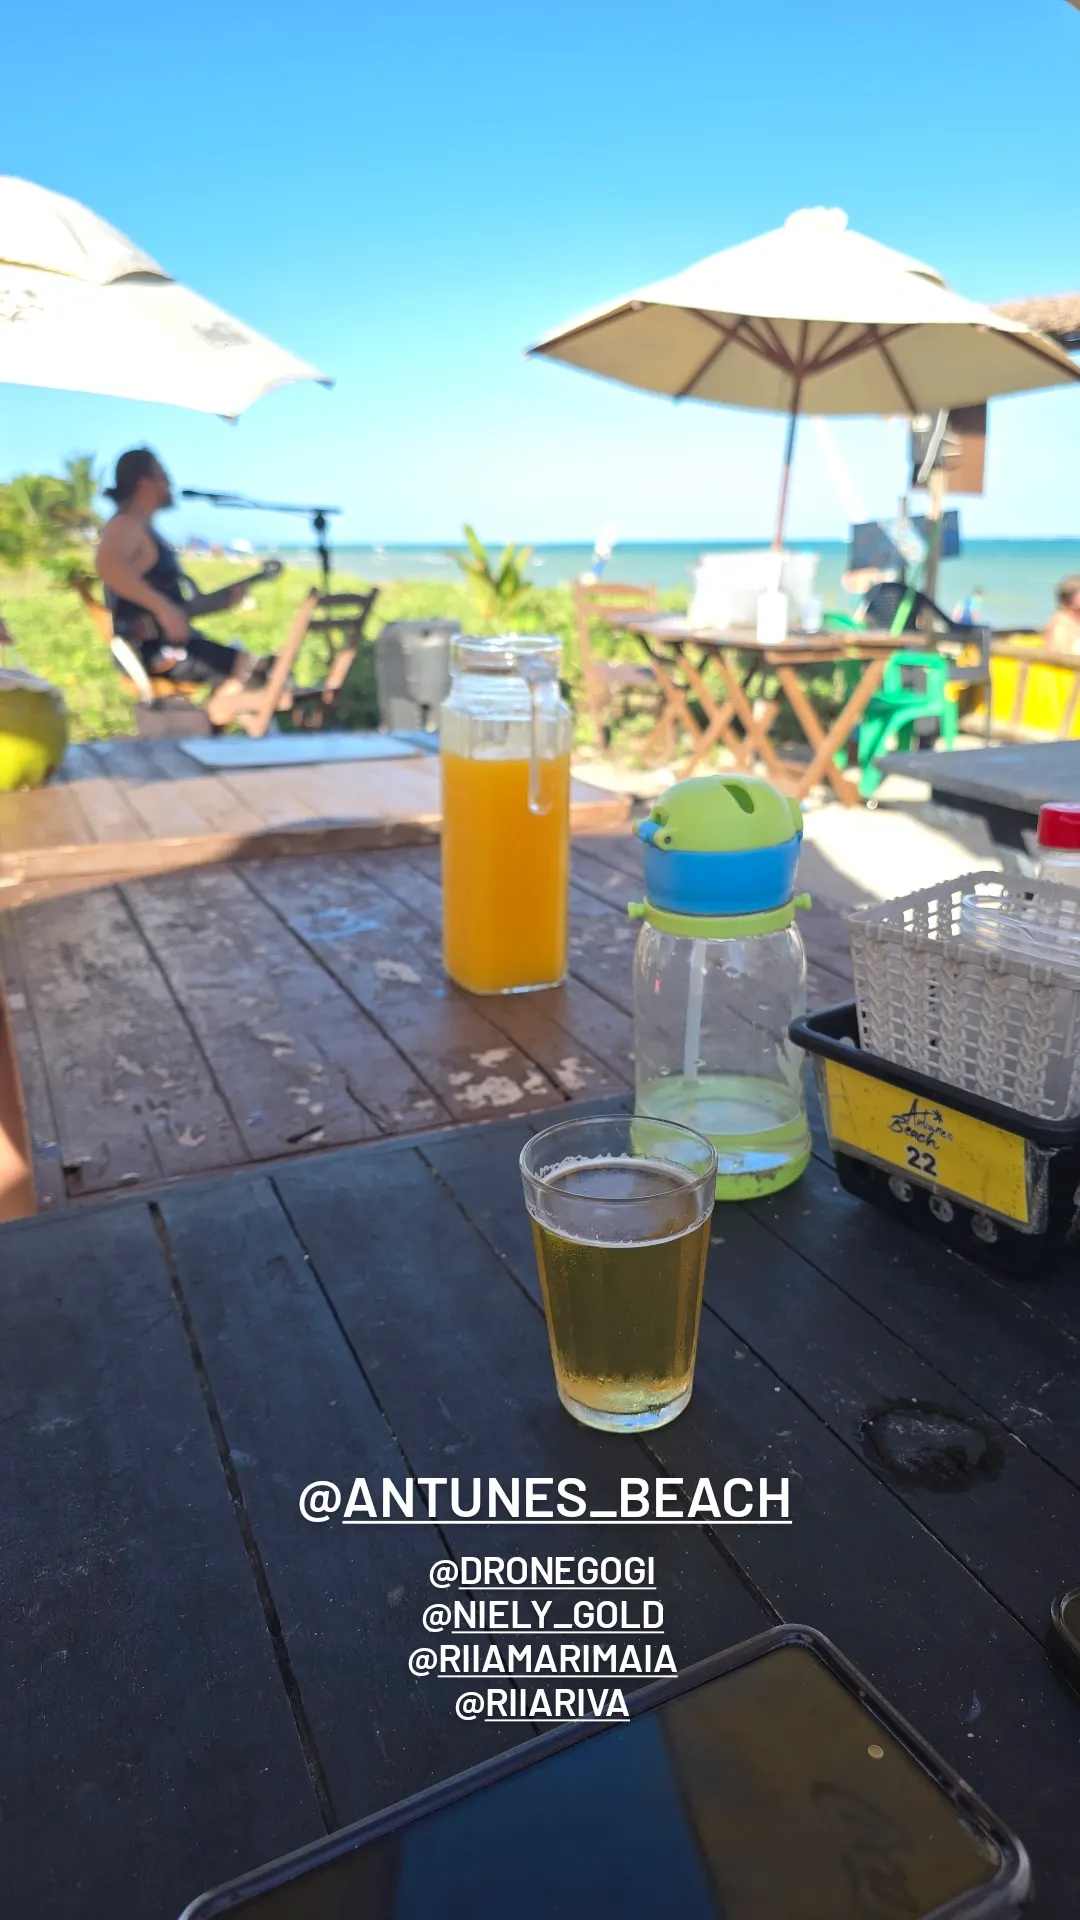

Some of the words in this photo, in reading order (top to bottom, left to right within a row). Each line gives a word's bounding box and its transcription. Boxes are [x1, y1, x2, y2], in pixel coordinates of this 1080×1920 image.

[888, 1116, 940, 1150] Beach
[892, 1098, 953, 1142] Antunes
[906, 1145, 937, 1176] 22
